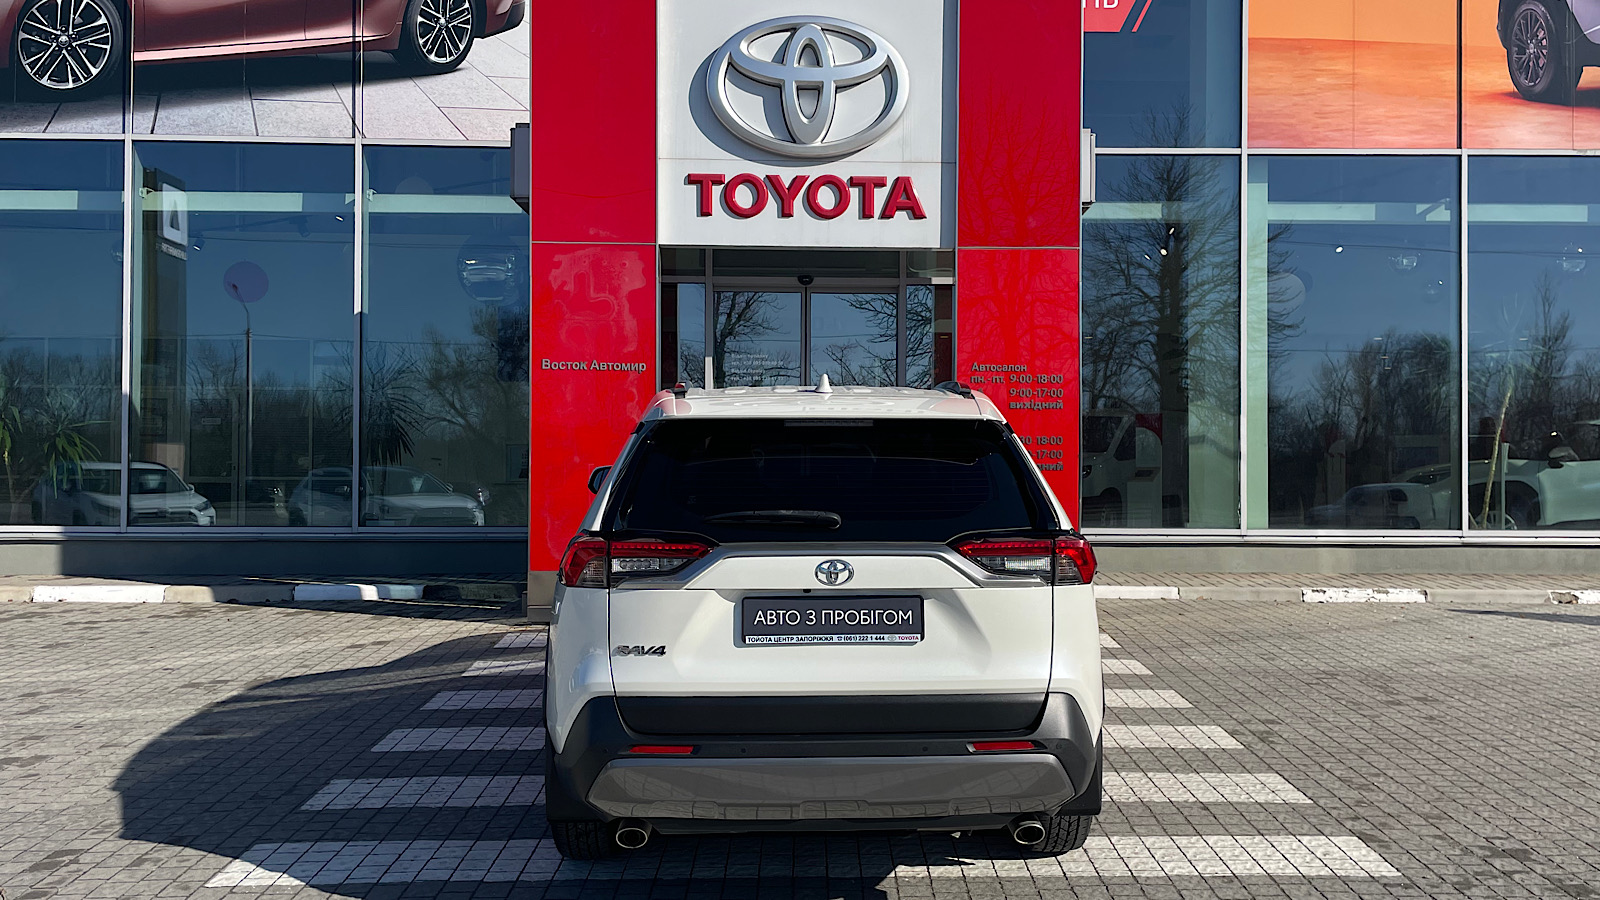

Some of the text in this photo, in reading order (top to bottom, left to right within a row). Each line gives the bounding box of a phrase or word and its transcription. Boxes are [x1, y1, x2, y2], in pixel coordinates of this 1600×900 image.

[685, 173, 927, 220] TOYOTA
[541, 358, 647, 374] Восток Автомир
[971, 361, 1028, 372] Автосалон
[1009, 388, 1064, 398] 9:00-17:00
[1009, 399, 1064, 411] вихідний
[753, 610, 801, 626] АВТО
[821, 609, 914, 626] ПРОБІГОМ
[611, 644, 667, 657] RAV4
